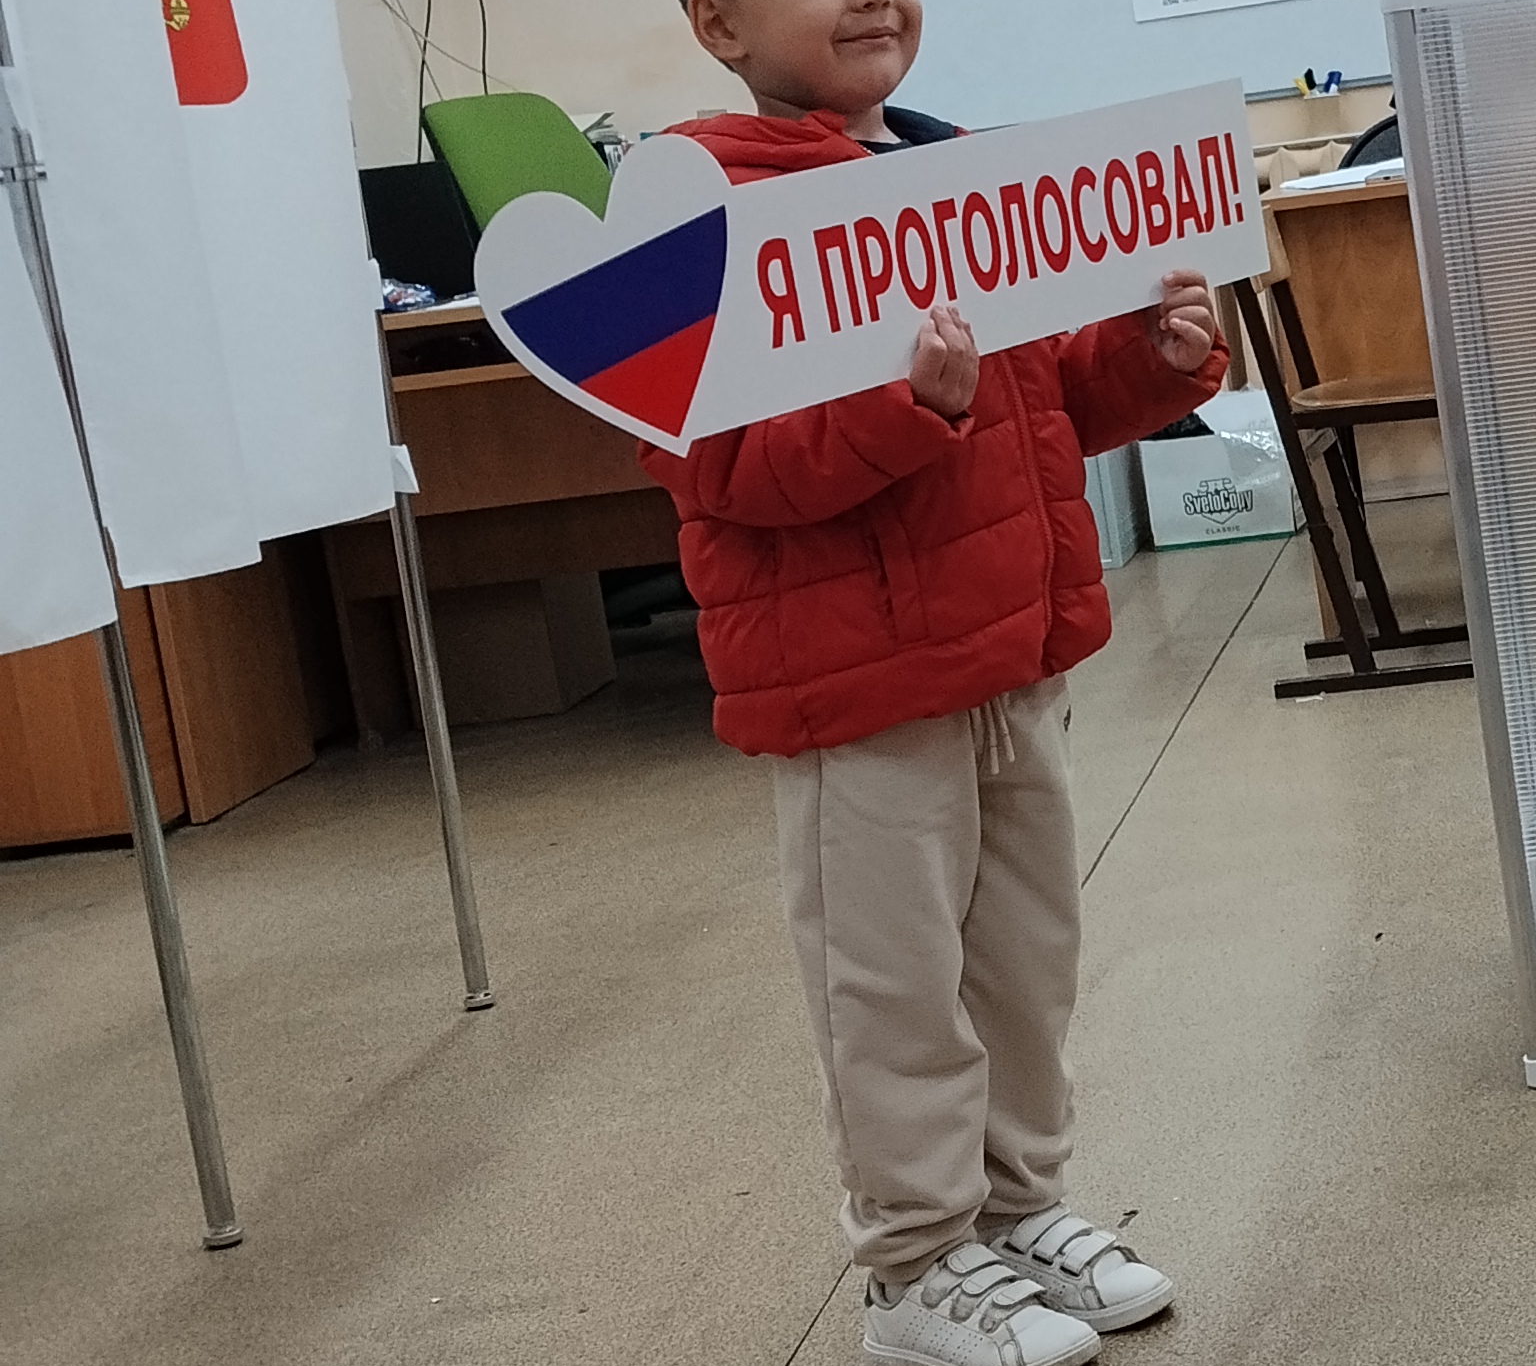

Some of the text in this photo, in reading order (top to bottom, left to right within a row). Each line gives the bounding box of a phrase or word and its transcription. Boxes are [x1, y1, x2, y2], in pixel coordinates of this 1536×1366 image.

[757, 132, 1245, 349] Я ПРОГОЛОСОВАЛ!
[1183, 489, 1253, 516] SvetoCopy
[1205, 525, 1241, 535] CLASSIC
